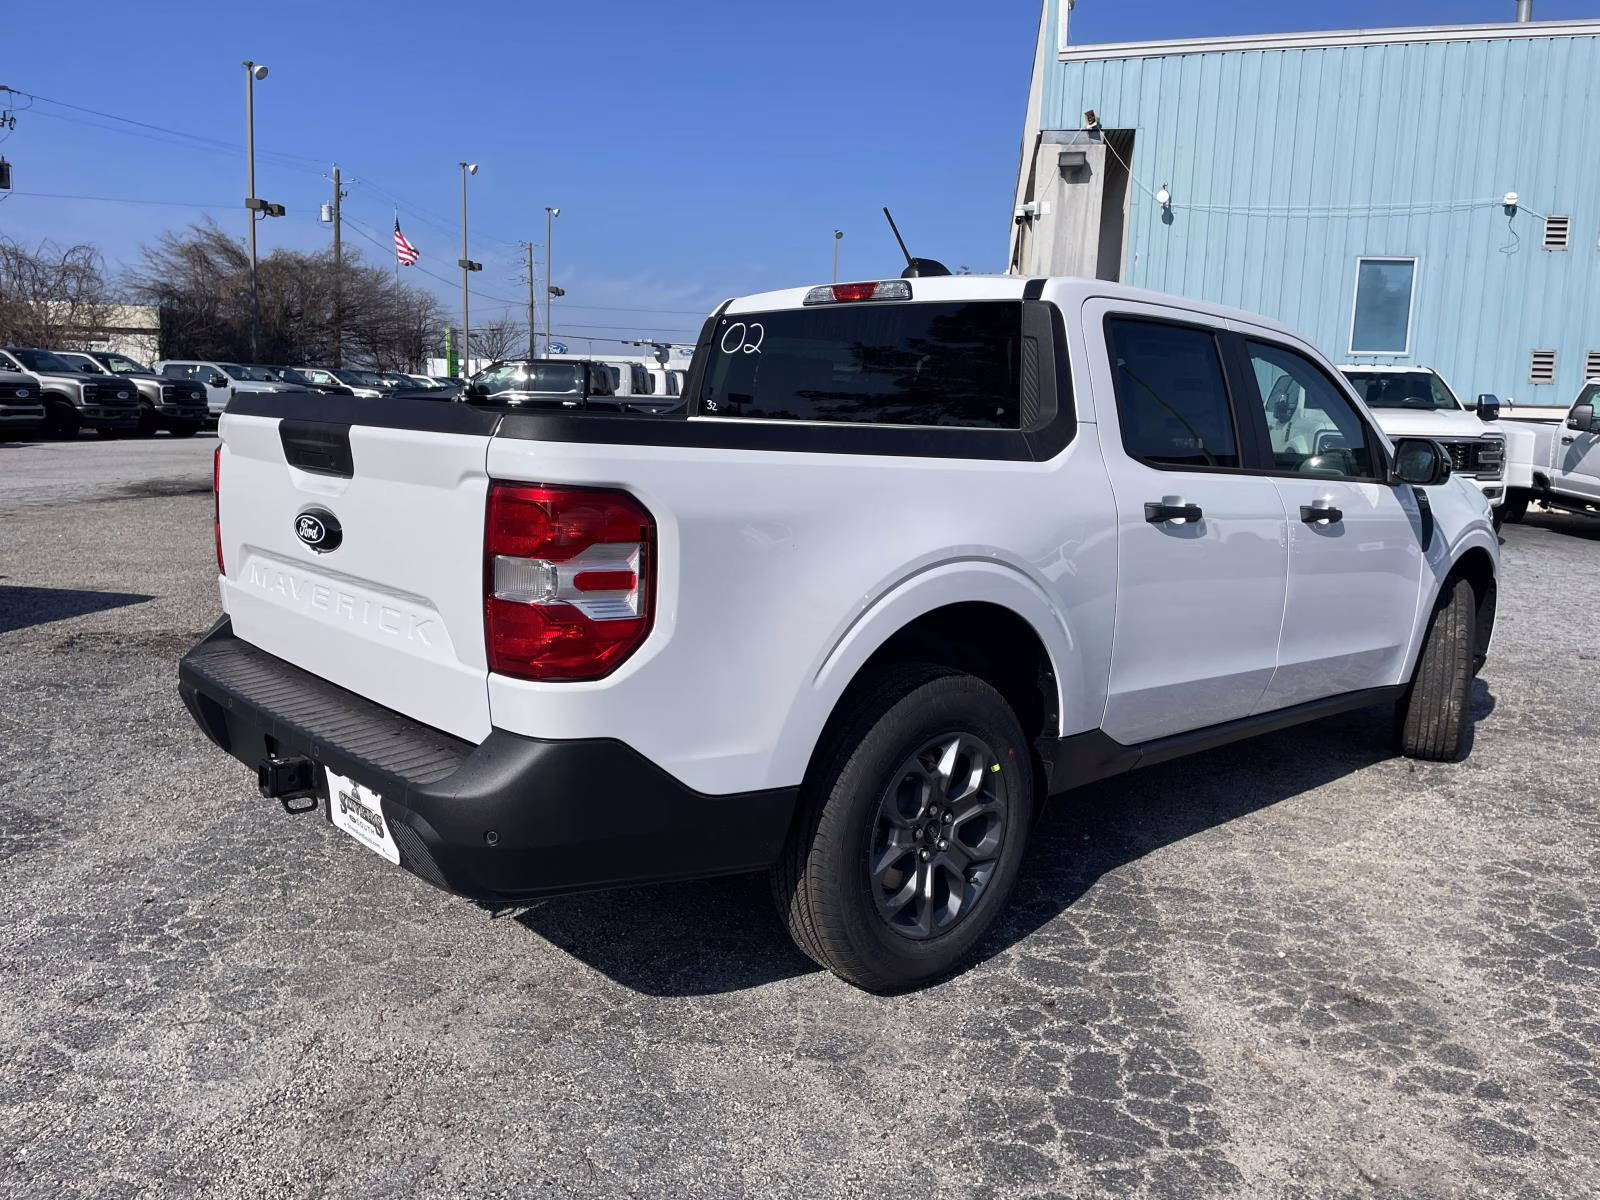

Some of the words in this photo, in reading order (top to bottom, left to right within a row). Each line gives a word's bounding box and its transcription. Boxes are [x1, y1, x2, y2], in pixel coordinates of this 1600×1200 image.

[721, 323, 764, 353] 02
[299, 518, 319, 540] Ford
[249, 563, 434, 646] MAVERICK
